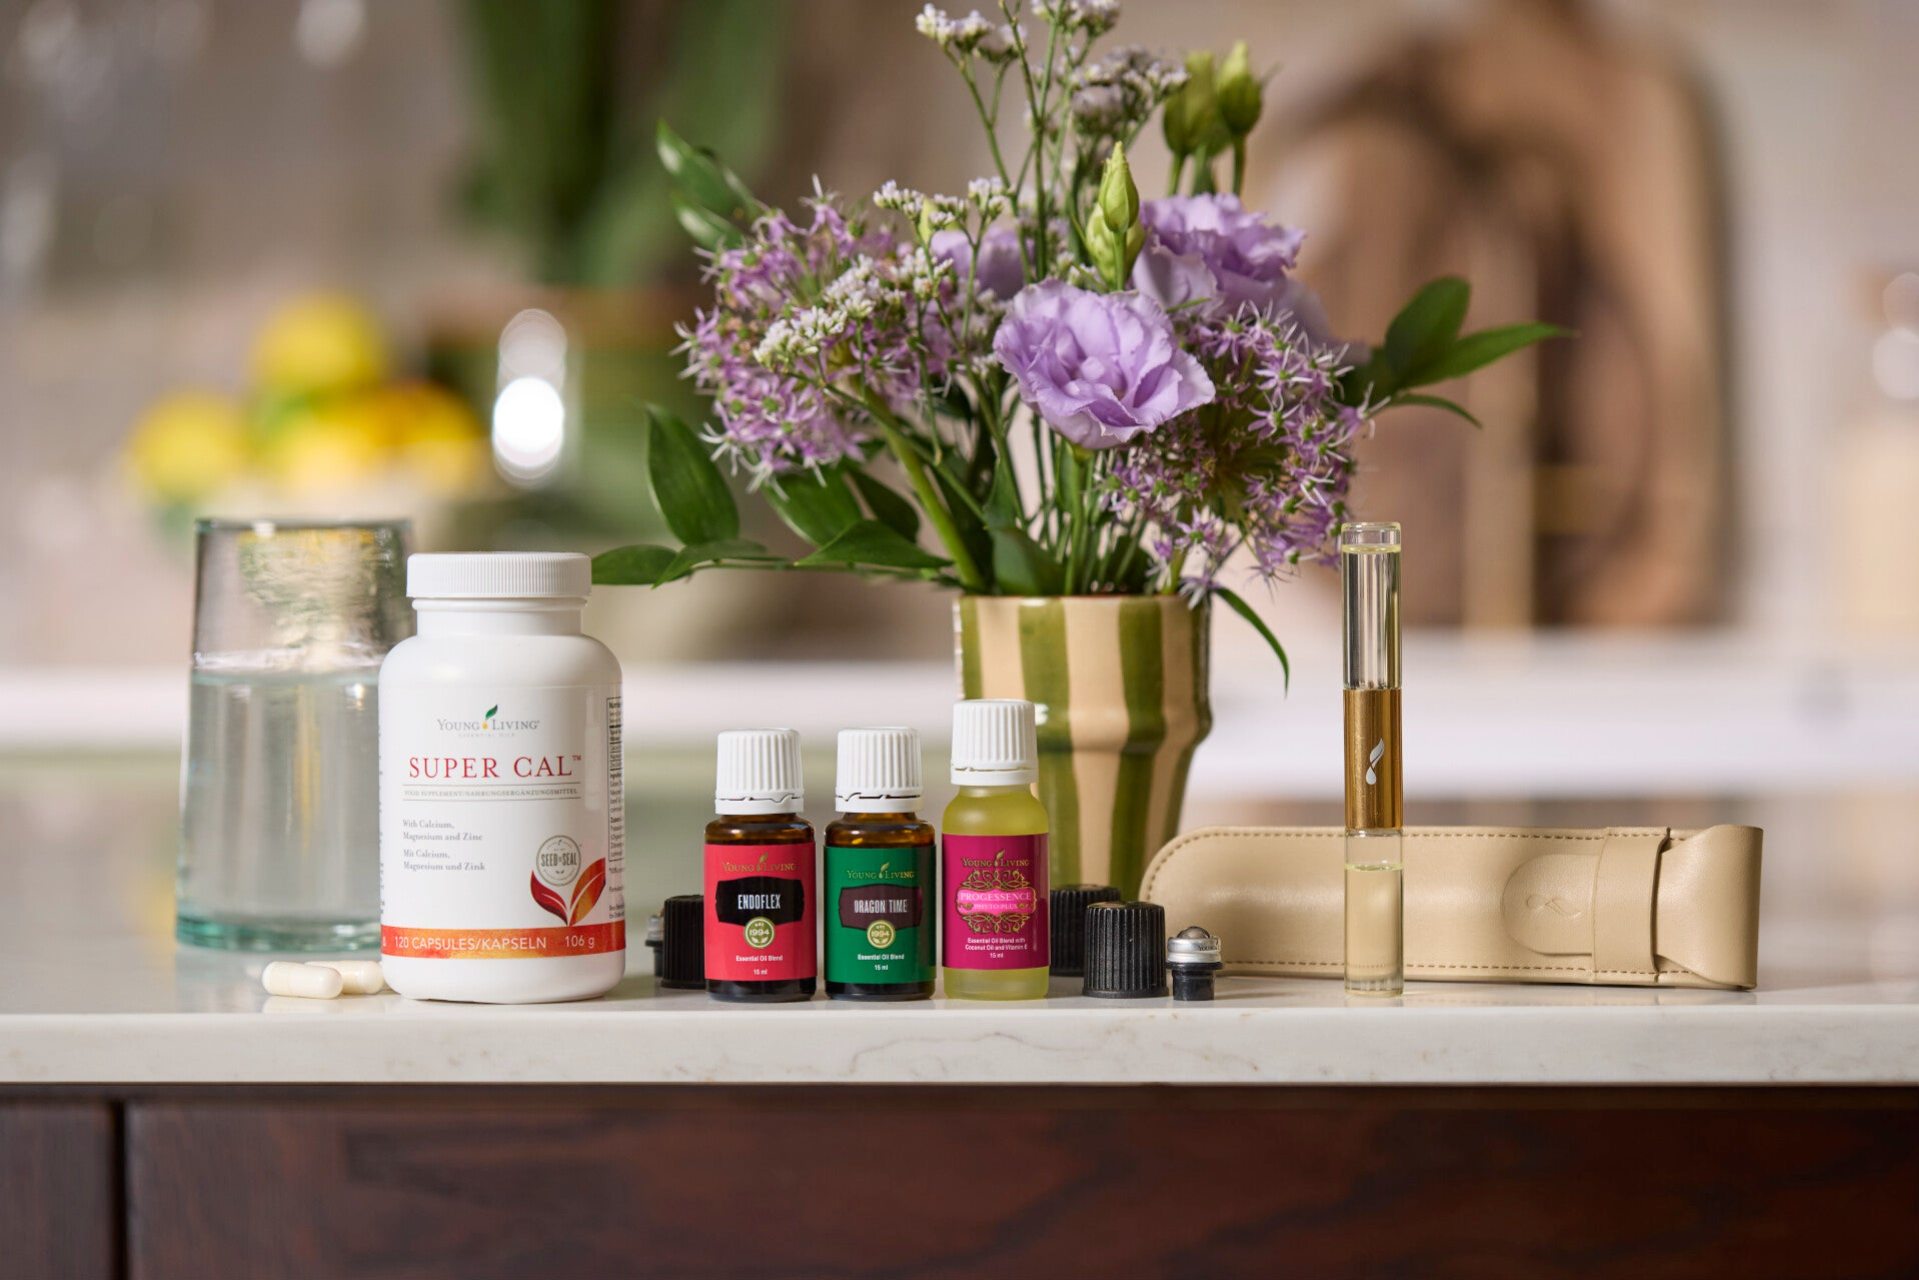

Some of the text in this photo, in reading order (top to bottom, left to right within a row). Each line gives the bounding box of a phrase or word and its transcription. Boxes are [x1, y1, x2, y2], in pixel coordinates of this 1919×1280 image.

[437, 719, 480, 731] YOUNG
[409, 756, 500, 779] SUPER
[402, 819, 455, 829] With Calcium,
[402, 831, 484, 842] Magnesium and Zinc
[403, 849, 414, 858] Mit
[540, 853, 558, 867] SEED
[562, 852, 578, 866] SEAL
[962, 858, 1030, 867] YOUNG LIVING
[403, 861, 486, 872] Magnesium und Zink
[722, 862, 797, 872] YOUNG LIVING
[847, 870, 915, 879] YOUNG LIVING
[737, 894, 781, 910] ENDOFLEX
[960, 892, 1032, 901] PROGESSENCE
[854, 900, 907, 914] DRAGON TIME
[749, 929, 769, 937] 1994
[394, 935, 409, 948] 120
[411, 936, 547, 951] CAPSULES/KAPSELN
[564, 935, 586, 948] 106
[588, 936, 595, 949] g
